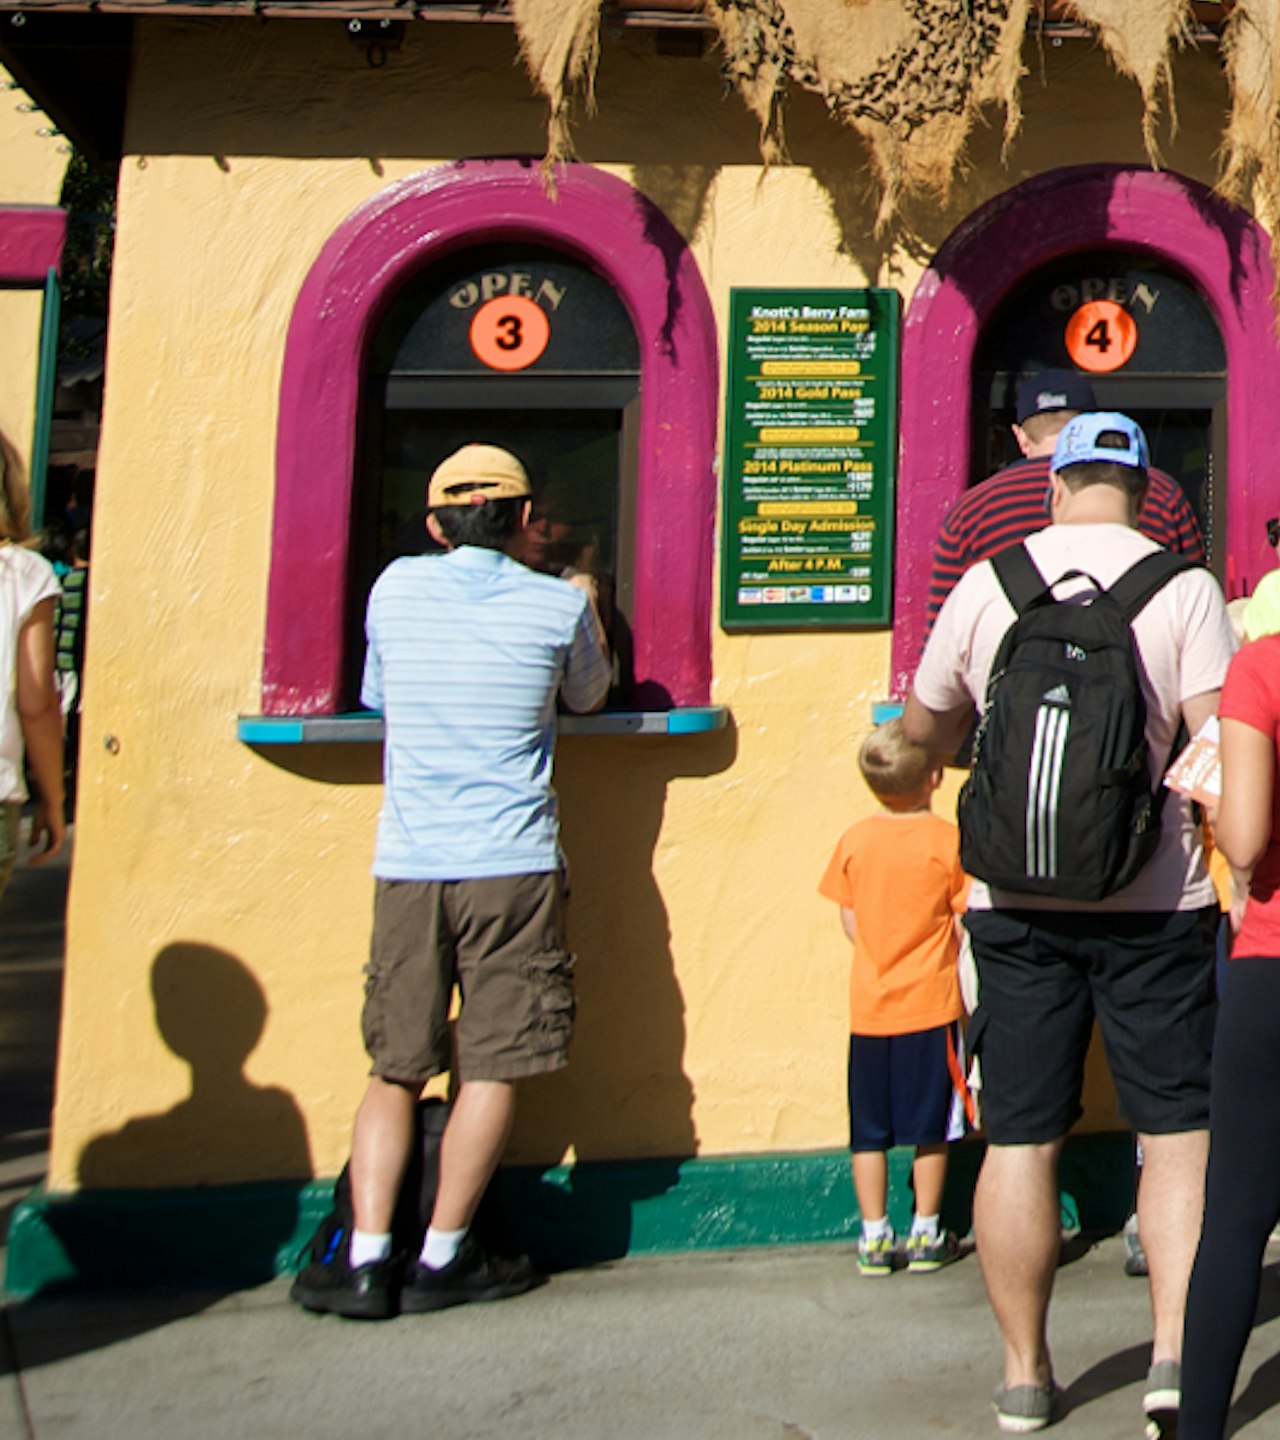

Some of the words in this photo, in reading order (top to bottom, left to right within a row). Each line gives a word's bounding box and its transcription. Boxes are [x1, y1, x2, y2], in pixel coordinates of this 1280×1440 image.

[450, 273, 567, 310] OPEN
[1050, 277, 1160, 314] OPEN
[751, 305, 800, 319] Knott's
[494, 315, 523, 350] 3
[752, 320, 787, 333] 2014
[789, 320, 839, 333] Season
[1085, 319, 1112, 353] 4
[759, 387, 793, 400] 2014
[795, 386, 829, 400] Gold
[831, 386, 862, 400] Pass
[742, 460, 777, 474] 2014
[779, 459, 841, 473] Platinum
[843, 459, 873, 472] Pass
[738, 520, 778, 535] Single
[781, 520, 807, 534] Day
[808, 519, 875, 532] Admission
[768, 557, 803, 572] After
[804, 558, 814, 570] 4
